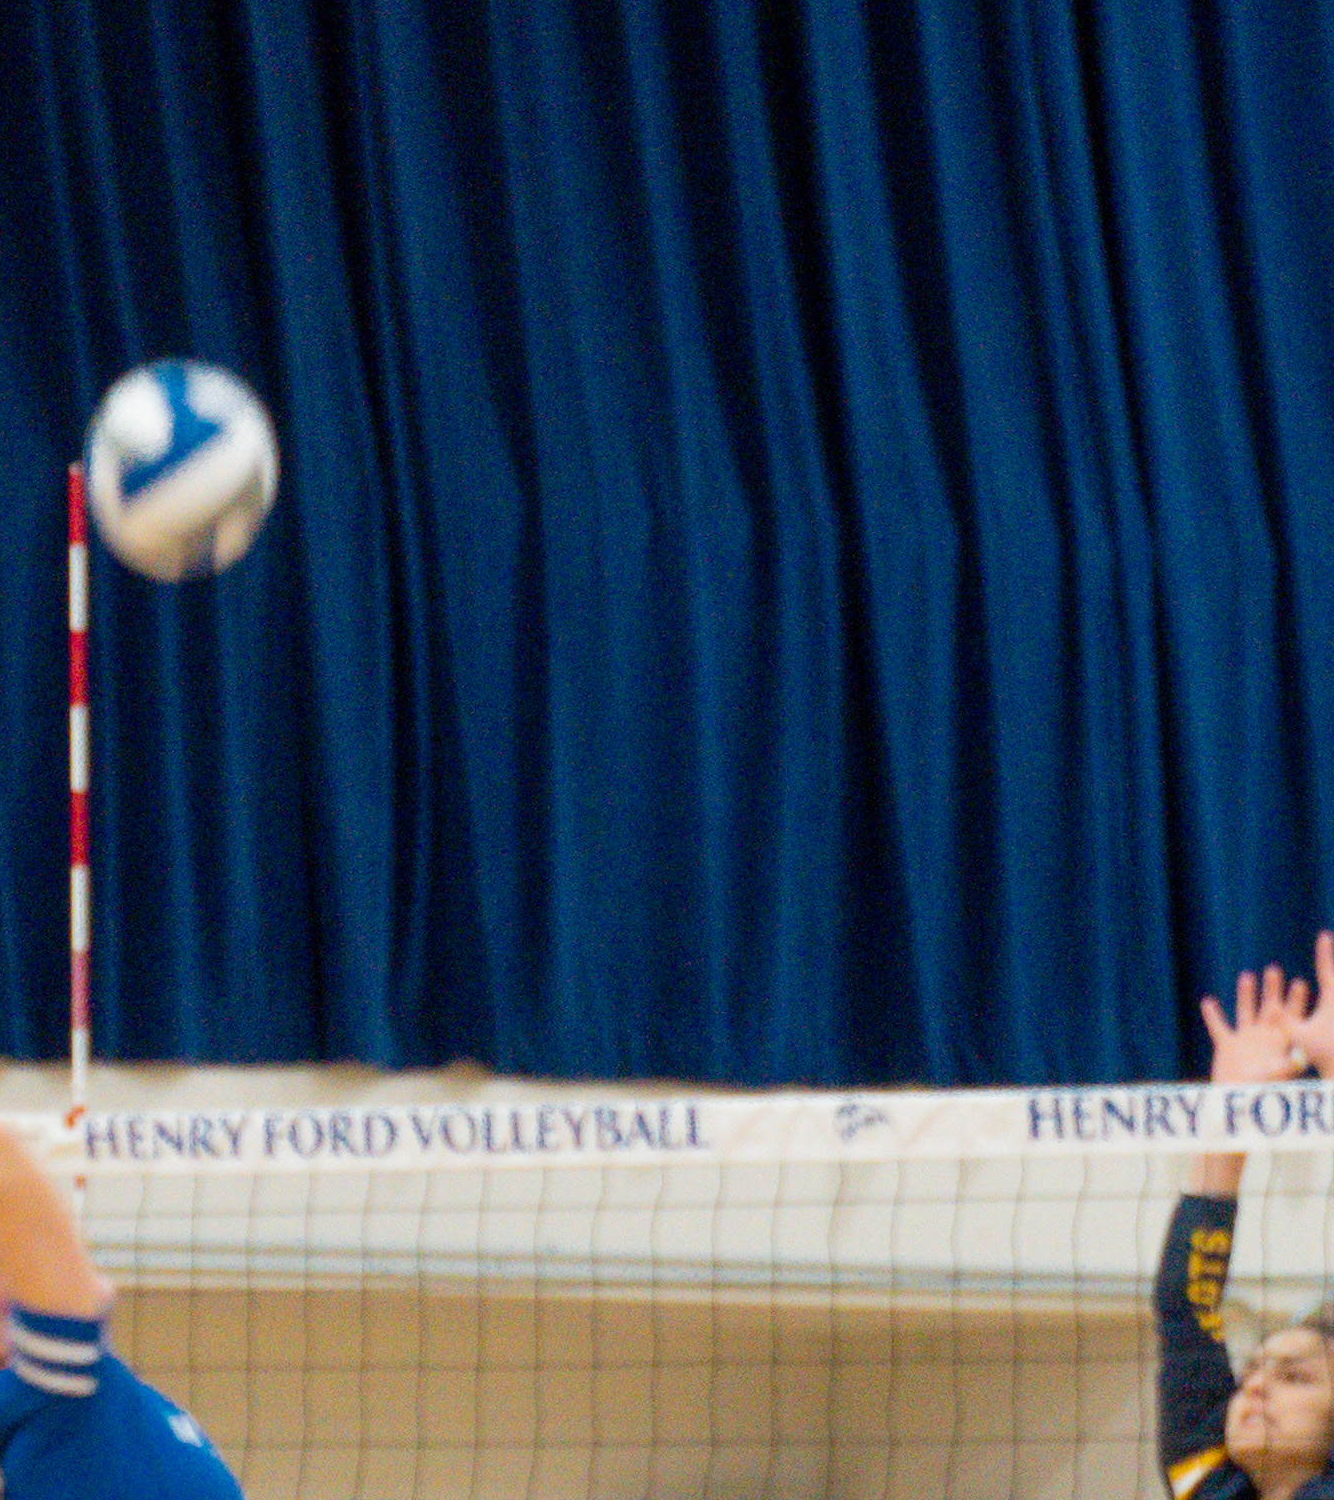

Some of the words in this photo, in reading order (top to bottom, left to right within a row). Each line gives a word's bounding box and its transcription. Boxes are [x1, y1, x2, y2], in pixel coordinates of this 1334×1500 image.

[84, 1112, 247, 1160] HENRY
[263, 1110, 399, 1156] FORD
[411, 1103, 711, 1155] VOLLEYBALL
[1027, 1095, 1201, 1141] HENRY
